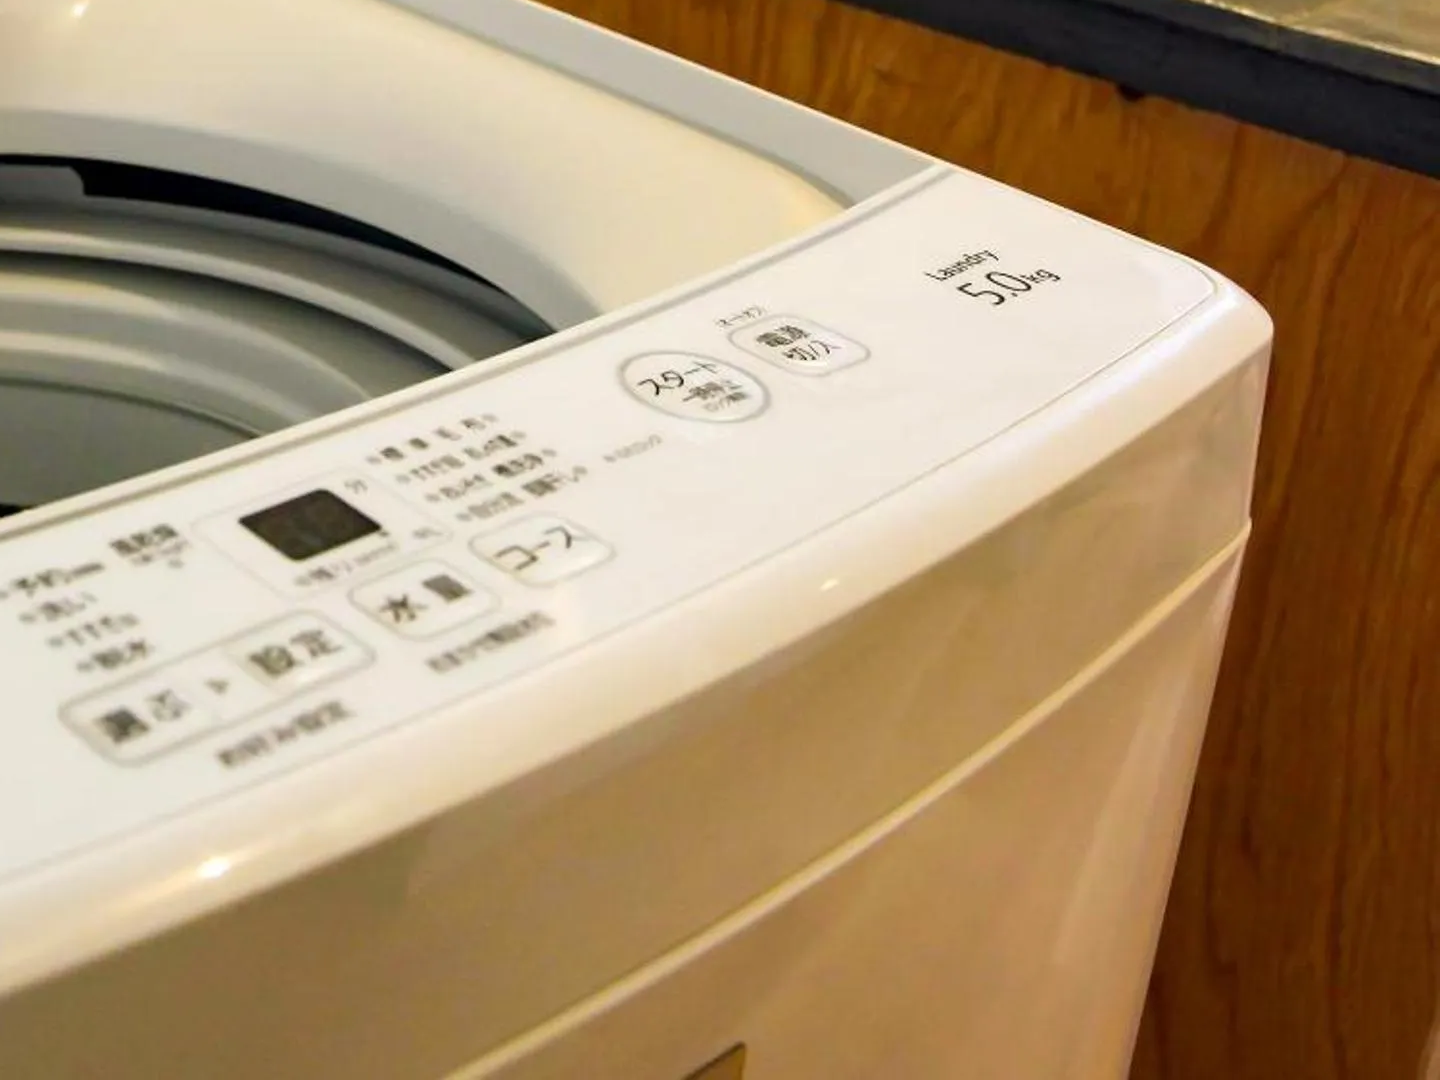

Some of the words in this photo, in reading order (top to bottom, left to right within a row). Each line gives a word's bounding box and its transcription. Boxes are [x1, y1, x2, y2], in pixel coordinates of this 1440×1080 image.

[923, 248, 1000, 283] Laundry
[956, 266, 1062, 306] 5.0kg
[637, 361, 718, 397] スタート
[493, 524, 590, 572] コース
